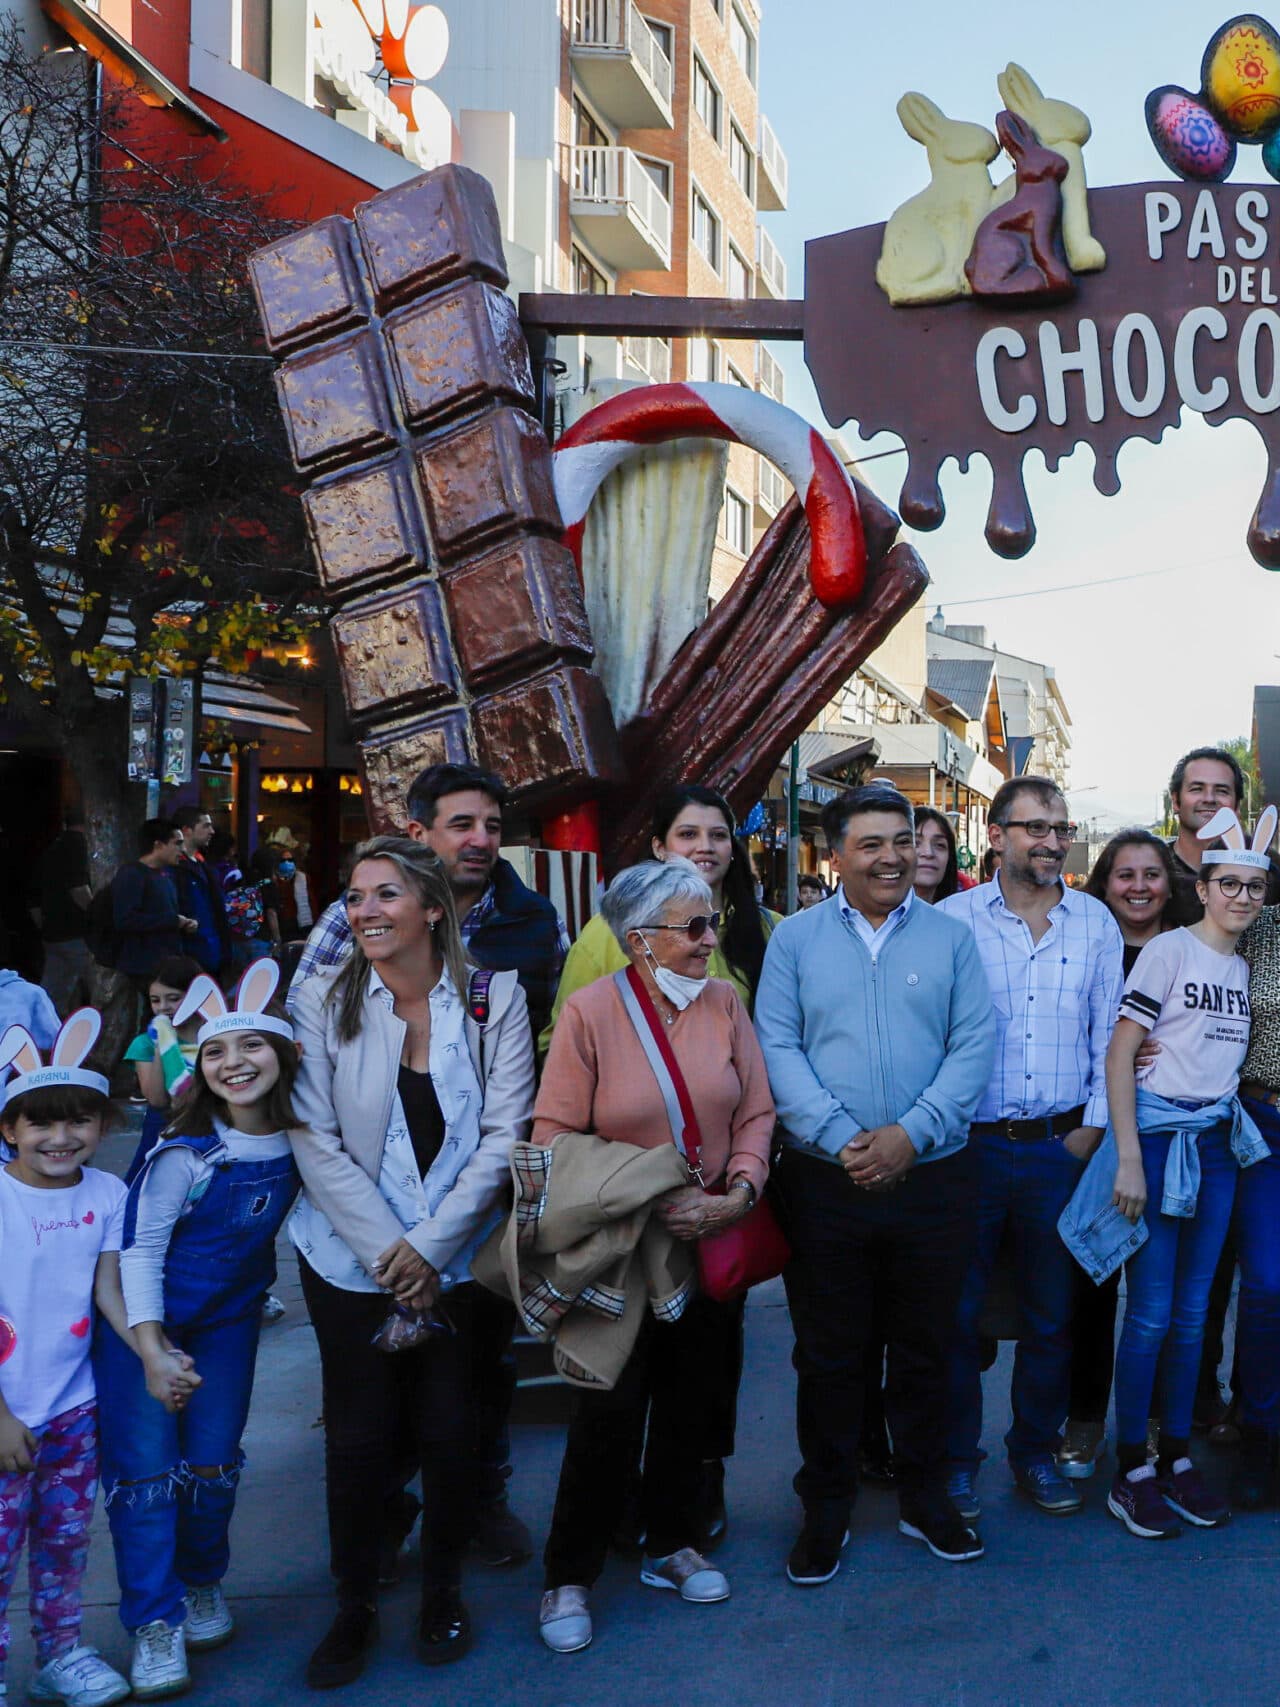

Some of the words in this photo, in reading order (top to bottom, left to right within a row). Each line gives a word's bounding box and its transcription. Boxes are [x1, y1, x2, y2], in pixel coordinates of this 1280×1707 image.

[1217, 265, 1278, 304] DEL
[1184, 982, 1223, 1013] SAN
[1226, 988, 1250, 1016] FR
